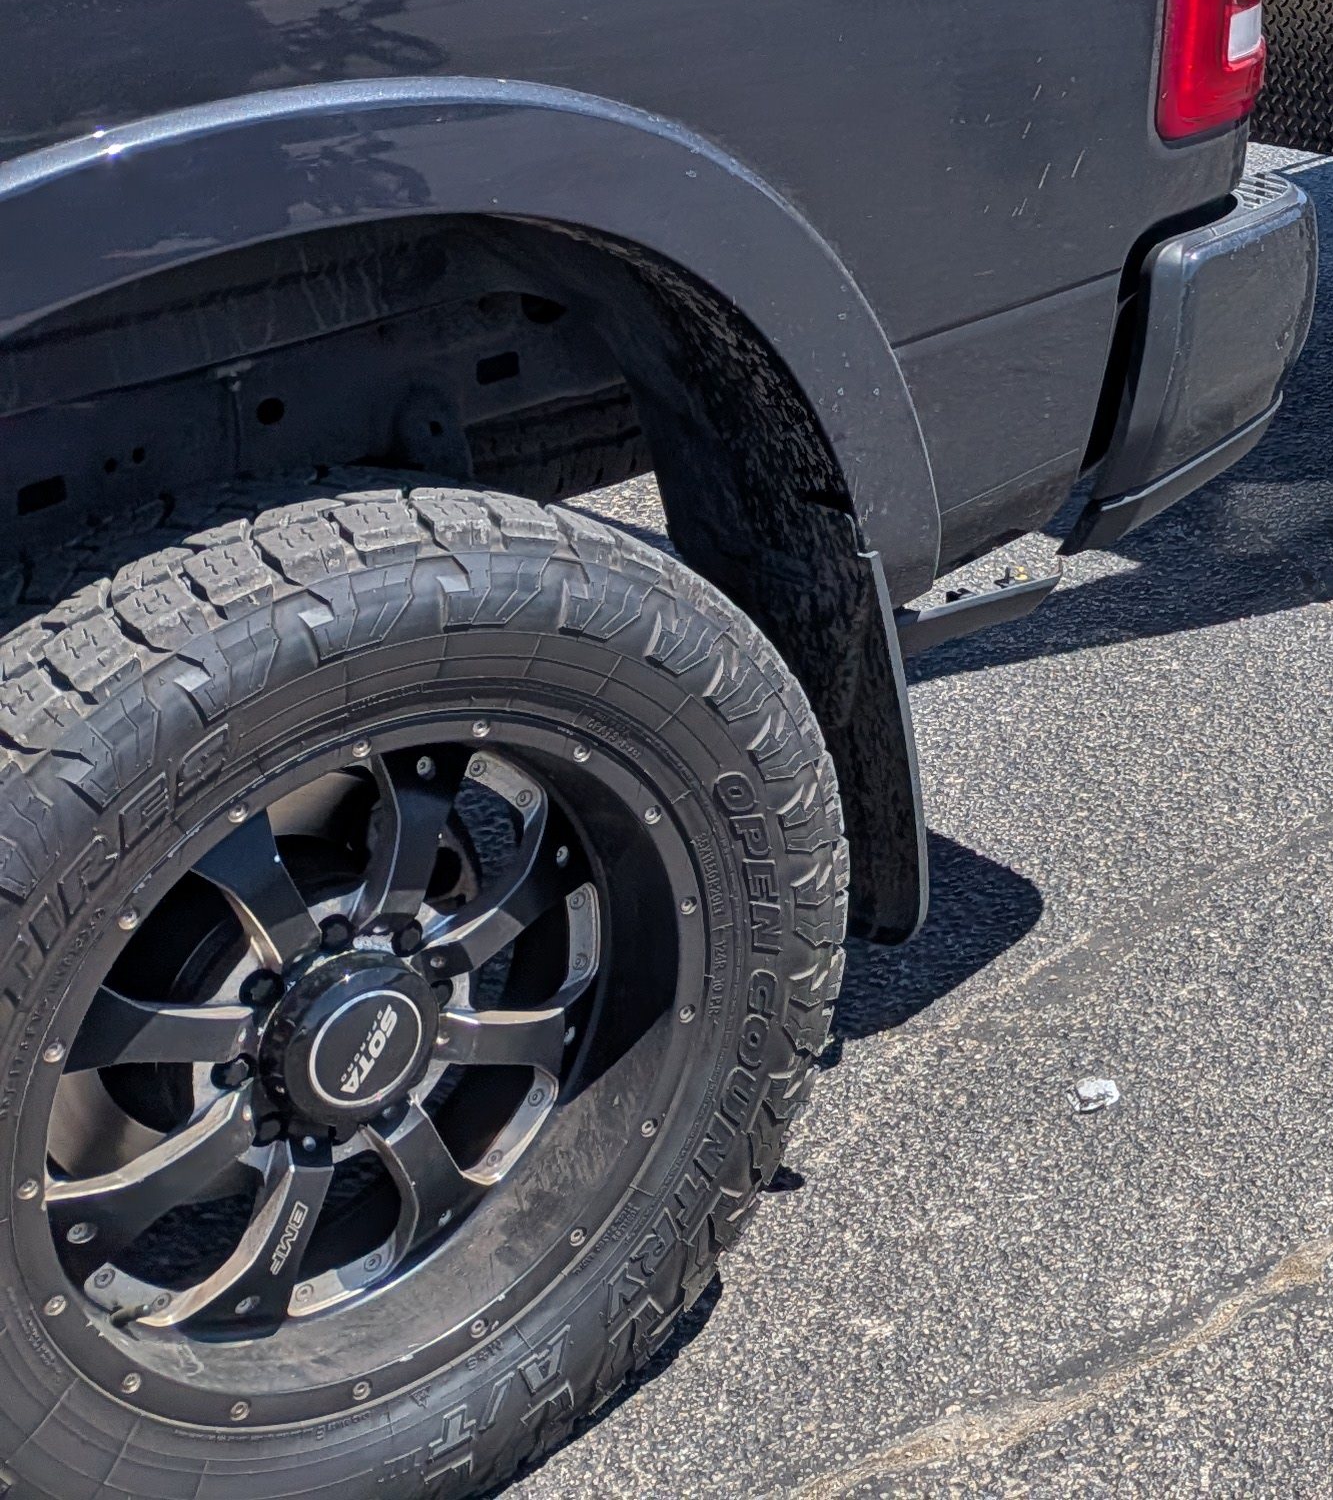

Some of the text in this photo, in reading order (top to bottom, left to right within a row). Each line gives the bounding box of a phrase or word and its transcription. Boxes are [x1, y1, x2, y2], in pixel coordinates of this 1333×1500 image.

[340, 1004, 398, 1094] SOTA
[428, 770, 784, 1463] OPEN COUNTRY A/T
[270, 1200, 309, 1276] BMF
